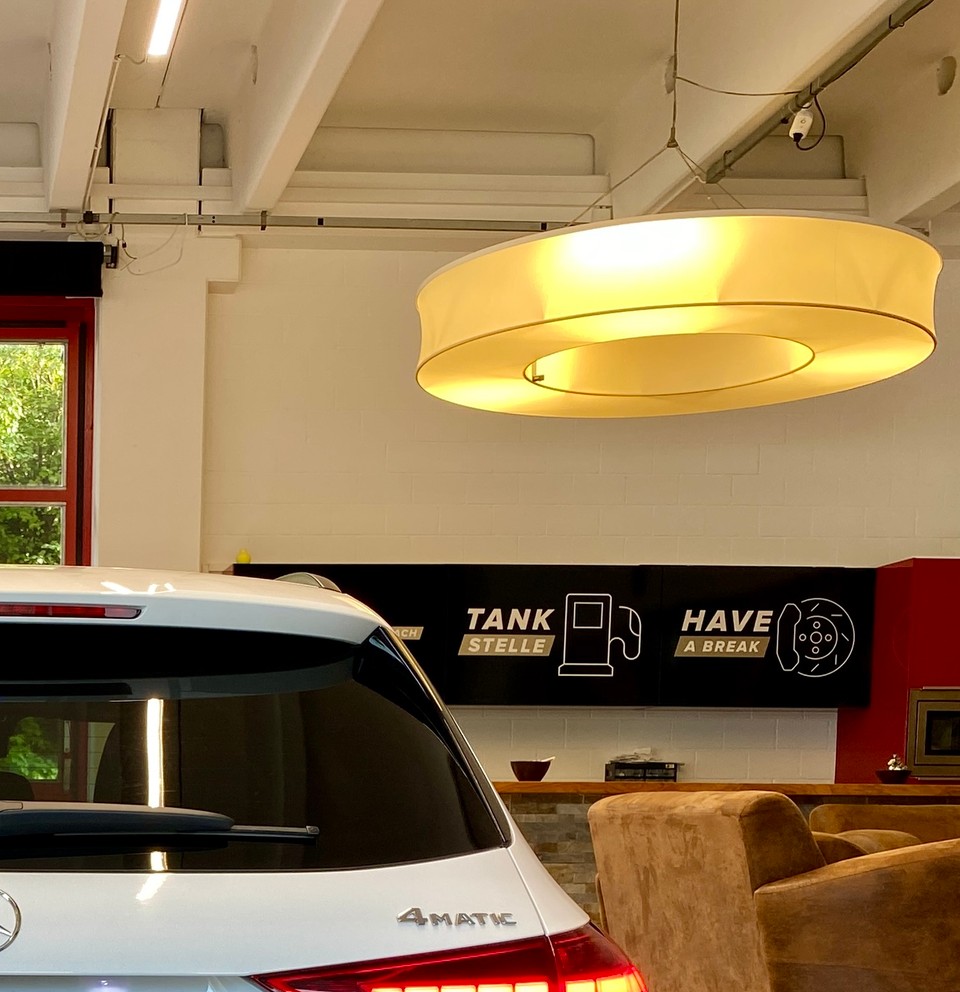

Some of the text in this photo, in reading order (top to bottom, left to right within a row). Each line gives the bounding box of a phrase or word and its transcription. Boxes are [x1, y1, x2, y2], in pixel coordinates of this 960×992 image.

[467, 608, 555, 631] TANK
[681, 609, 774, 632] HAVE
[467, 637, 546, 653] STELLE
[683, 640, 761, 653] A BREAK
[396, 907, 517, 926] 4MATIC
